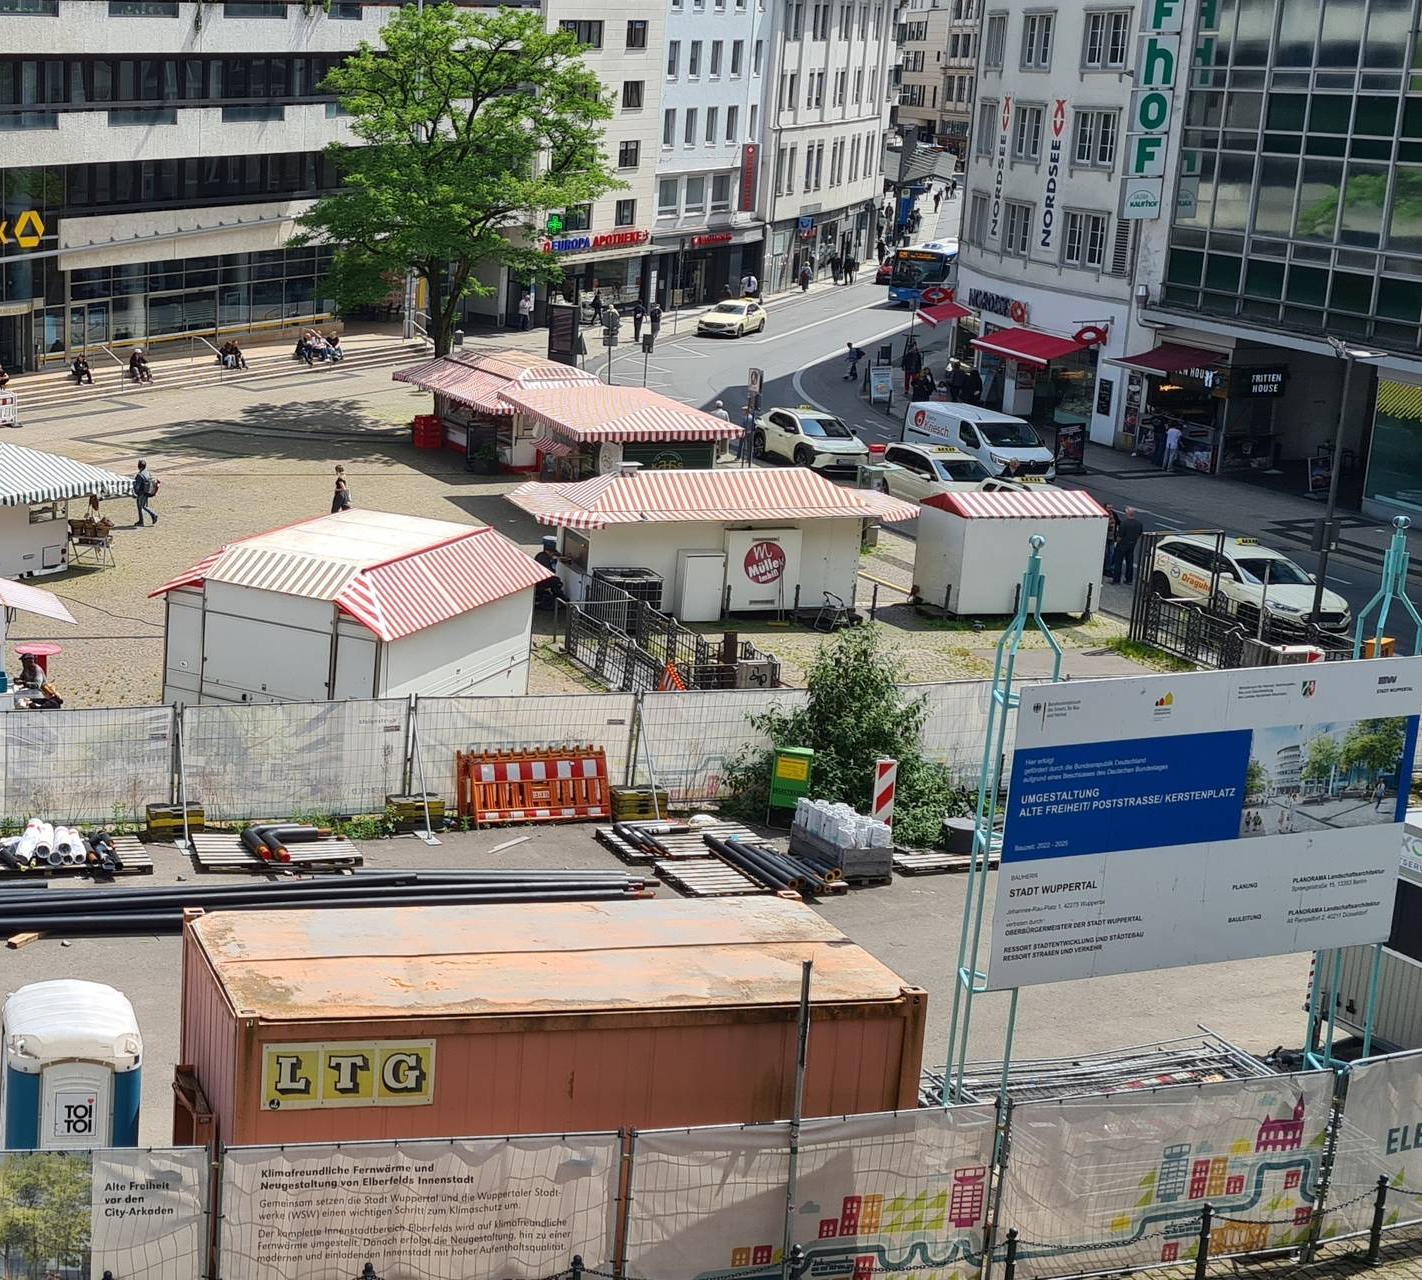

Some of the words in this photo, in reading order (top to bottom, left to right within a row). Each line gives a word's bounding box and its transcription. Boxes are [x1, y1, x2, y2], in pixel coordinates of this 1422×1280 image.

[991, 134, 1007, 236] NORDSEE
[1041, 139, 1062, 247] NORDSEE
[551, 237, 590, 251] EUROPA
[593, 230, 642, 247] APOTHEKE
[1251, 373, 1282, 383] FRITTEN
[1252, 383, 1279, 393] HOUSE
[1019, 804, 1044, 818] ALTE
[1045, 800, 1091, 815] FREIHEIT/
[1092, 794, 1164, 810] POSTSTRASSE/
[1165, 787, 1236, 804] KERSTENPLATZ
[1020, 788, 1100, 805] UMGESTALTUNG
[1292, 873, 1328, 884] PLANORAMA
[1327, 868, 1385, 880] Landschaftsarchitektur
[1009, 886, 1039, 898] STADT
[1041, 880, 1098, 895] WUPPERTAL
[1232, 882, 1258, 890] PLANUNG
[1288, 906, 1323, 916] PLANORAMA
[1322, 900, 1381, 913] Landschaftsarchitektur
[1005, 922, 1073, 937] OBERBÜRGERMEISTER
[1073, 921, 1086, 929] DER
[1086, 918, 1106, 927] STADT
[1106, 915, 1143, 925] WUPPERTAL
[1228, 913, 1262, 923] BAULEITUNG
[1003, 944, 1032, 953] RESSORT
[1033, 937, 1095, 951] STADTENTWICKLUNG
[1095, 935, 1109, 943] UND
[1109, 931, 1145, 941] STÄDTEBAU
[1002, 953, 1031, 962] RESSORT
[1060, 948, 1073, 956] UND
[1074, 944, 1103, 953] VERKEHR
[65, 1104, 93, 1117] TOI
[65, 1118, 93, 1133] TOI
[261, 1165, 350, 1179] Klimafreundliche
[353, 1164, 412, 1175] Fernwärme
[414, 1163, 435, 1172] und
[104, 1181, 125, 1191] Alte
[128, 1181, 170, 1191] Freiheit
[260, 1178, 338, 1192] Neugestaltung
[340, 1179, 359, 1187] von
[362, 1175, 414, 1186] Elberfelds
[418, 1175, 474, 1185] Innenstadt
[104, 1195, 120, 1204] vor
[124, 1194, 144, 1204] den
[260, 1198, 313, 1209] Gemeinsam
[315, 1198, 345, 1206] setzen
[347, 1195, 362, 1205] die
[364, 1193, 388, 1205] Stadt
[390, 1191, 439, 1204] Wuppertal
[441, 1193, 459, 1202] und
[461, 1192, 476, 1202] die
[477, 1187, 532, 1203] Wuppertaler
[534, 1186, 562, 1198] Stadt-
[104, 1206, 174, 1219] City-Arkaden
[258, 1211, 286, 1221] werke
[288, 1210, 320, 1222] (WSW)
[322, 1209, 347, 1217] einen
[349, 1206, 393, 1218] wichtigen
[394, 1204, 426, 1216] Schritt
[427, 1206, 447, 1215] zum
[449, 1202, 503, 1215] Klimaschutz
[258, 1227, 275, 1238] Der
[278, 1226, 322, 1240] komplette
[324, 1223, 406, 1236] Innenstadtbereich
[408, 1222, 453, 1233] Elberfelds
[455, 1220, 476, 1231] wird
[477, 1219, 492, 1230] auf
[494, 1216, 568, 1229] klimafreundliche
[257, 1240, 309, 1251] Fernwärme
[310, 1237, 361, 1250] umgestellt.
[363, 1236, 398, 1247] Danach
[400, 1235, 433, 1246] erfolgt
[434, 1235, 448, 1245] die
[450, 1233, 517, 1246] Neugestaltung,
[519, 1229, 533, 1239] hin
[535, 1231, 547, 1240] zu
[549, 1229, 571, 1239] einer
[257, 1252, 304, 1263] modernen
[305, 1250, 323, 1260] und
[324, 1247, 382, 1260] einladenden
[383, 1249, 432, 1257] Innenstadt
[434, 1247, 449, 1256] mit
[451, 1246, 478, 1256] hoher
